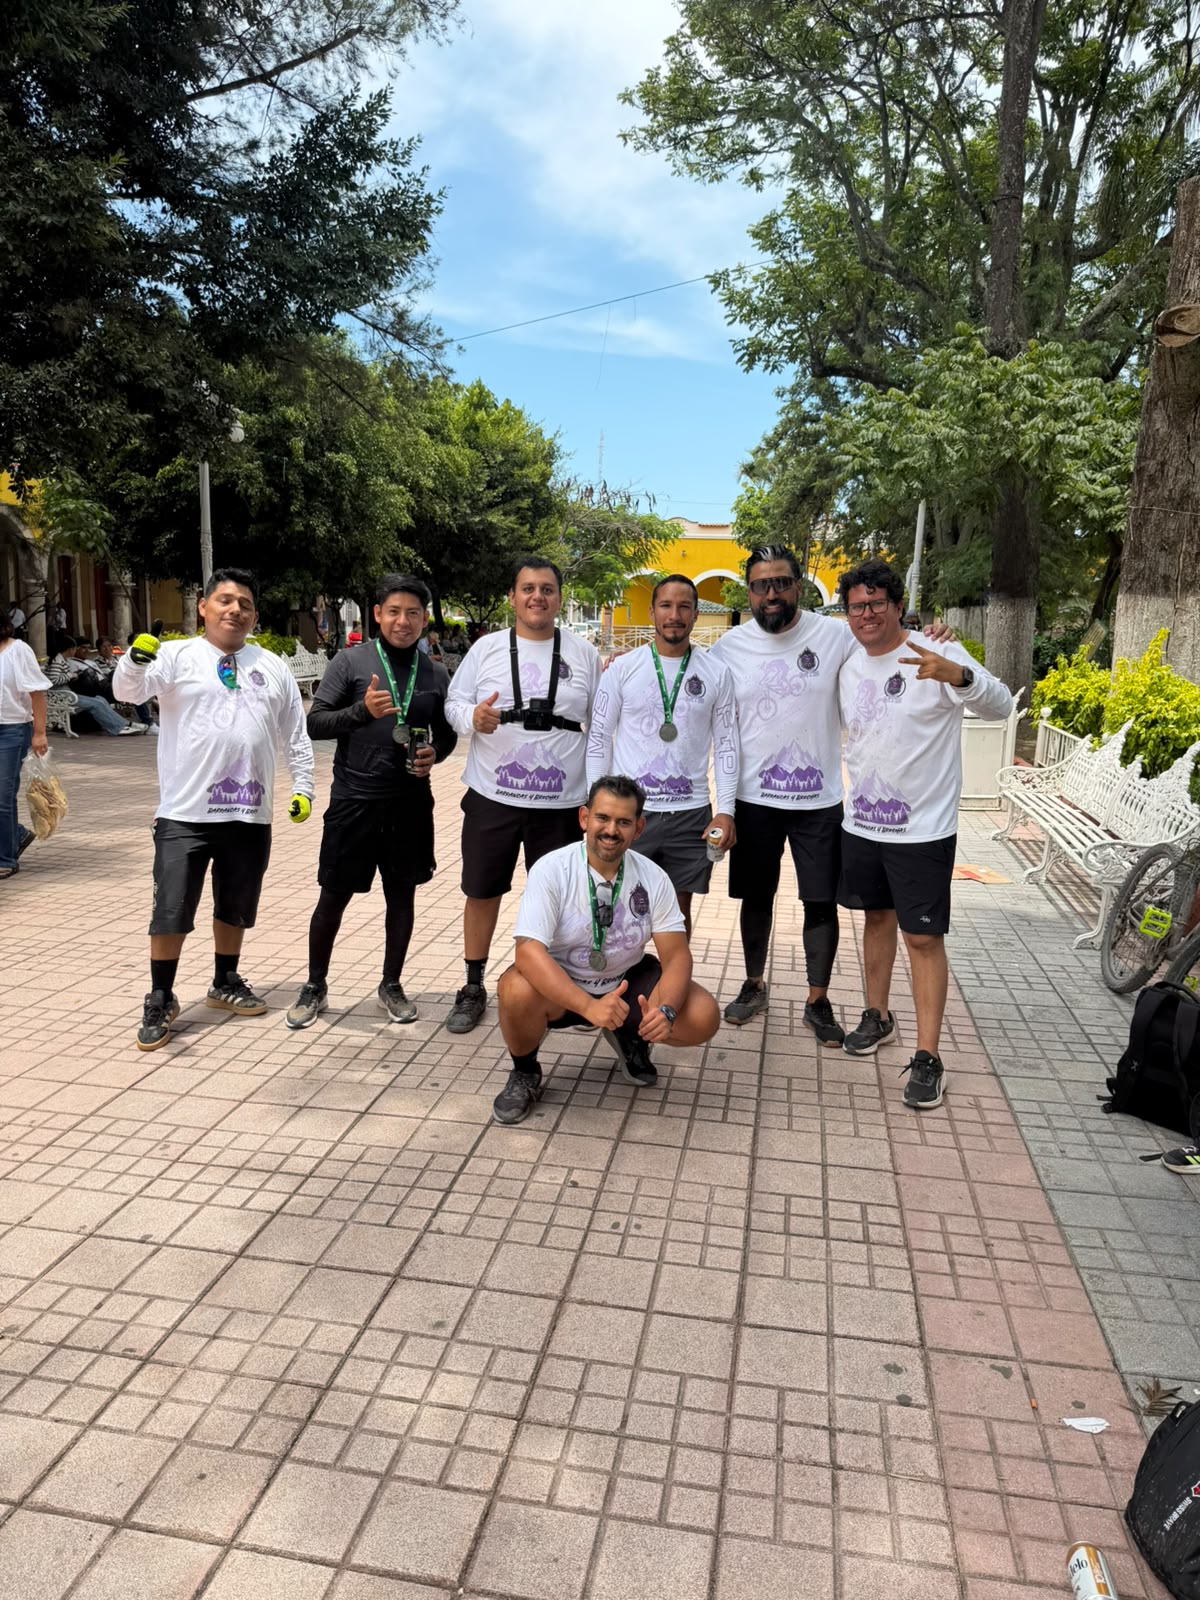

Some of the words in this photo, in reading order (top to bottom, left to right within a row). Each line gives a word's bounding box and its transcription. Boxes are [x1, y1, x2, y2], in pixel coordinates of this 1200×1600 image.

[587, 689, 609, 759] MTB
[1175, 1496, 1193, 1515] SWISS
[1163, 1510, 1180, 1532] BRAVE
